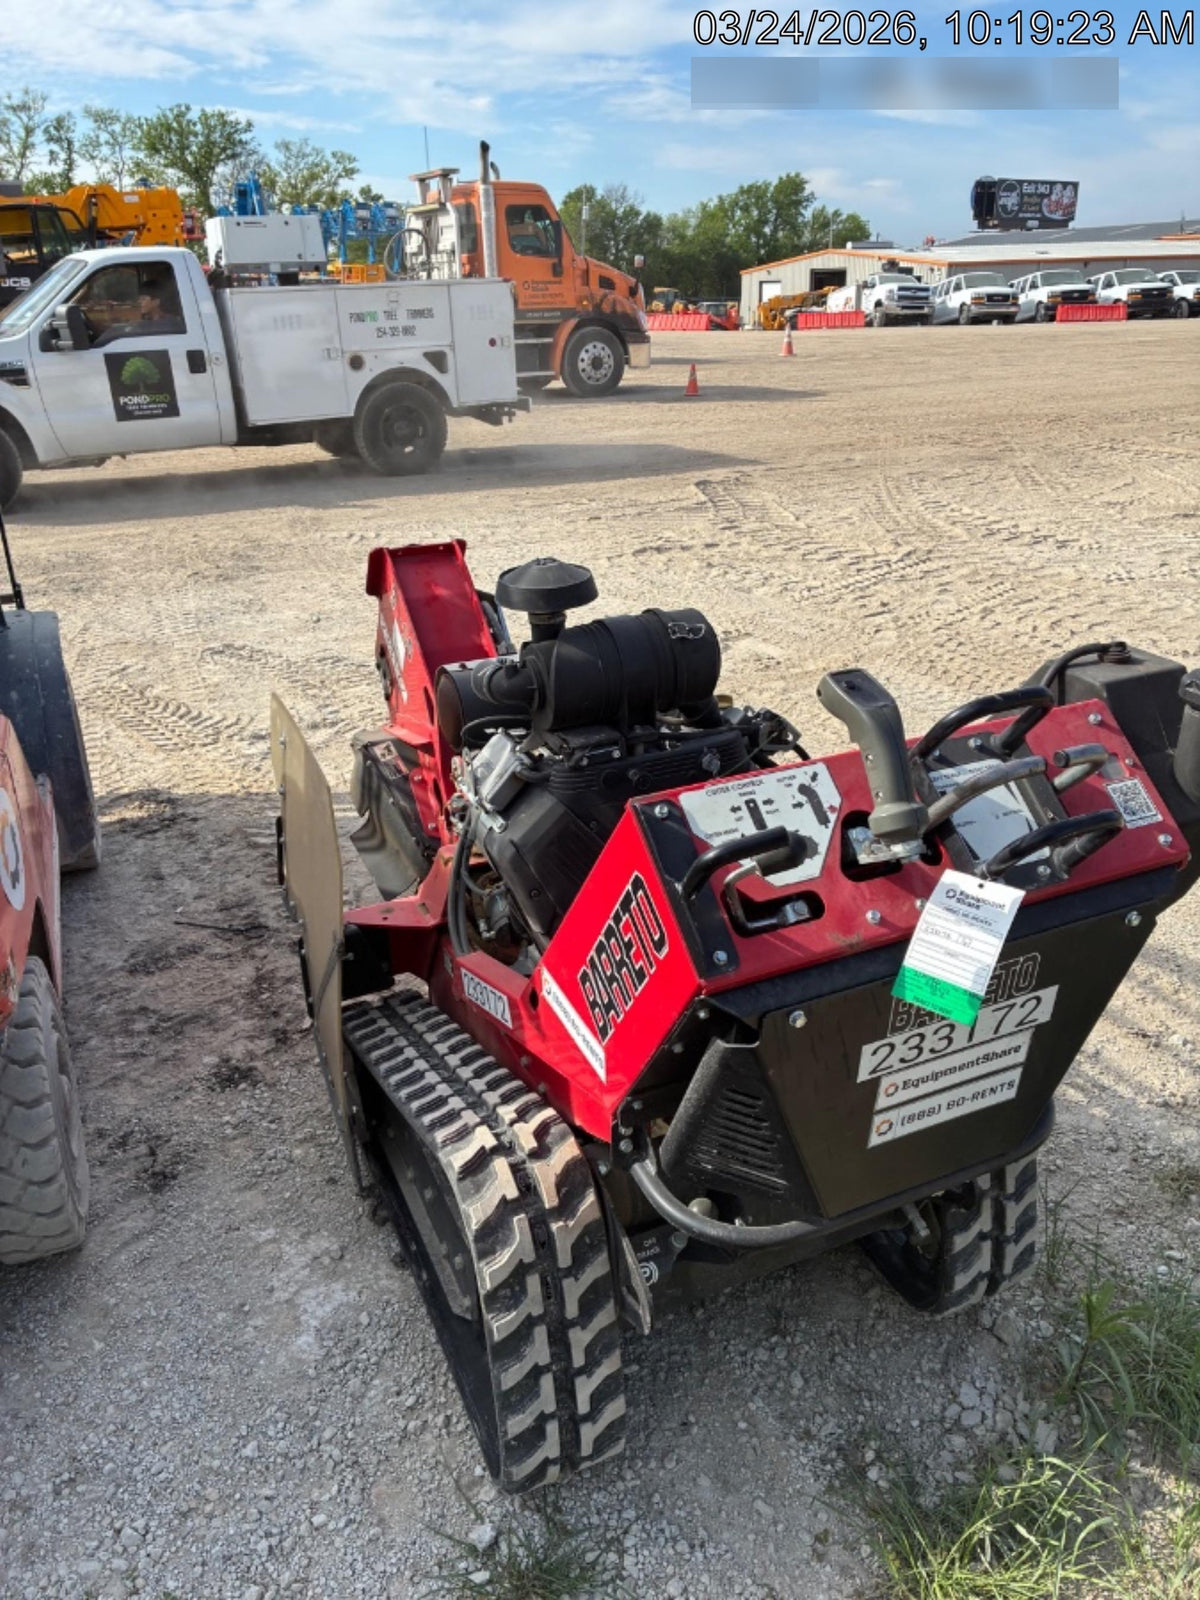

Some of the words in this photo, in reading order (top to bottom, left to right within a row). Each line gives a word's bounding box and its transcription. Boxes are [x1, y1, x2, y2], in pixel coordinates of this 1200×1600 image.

[578, 870, 669, 1046] BARRETO
[868, 995, 1043, 1076] 233172
[901, 1044, 1023, 1091] EquipmentShare
[901, 1103, 942, 1127] (888)
[946, 1080, 1016, 1111] 80-RENTS
